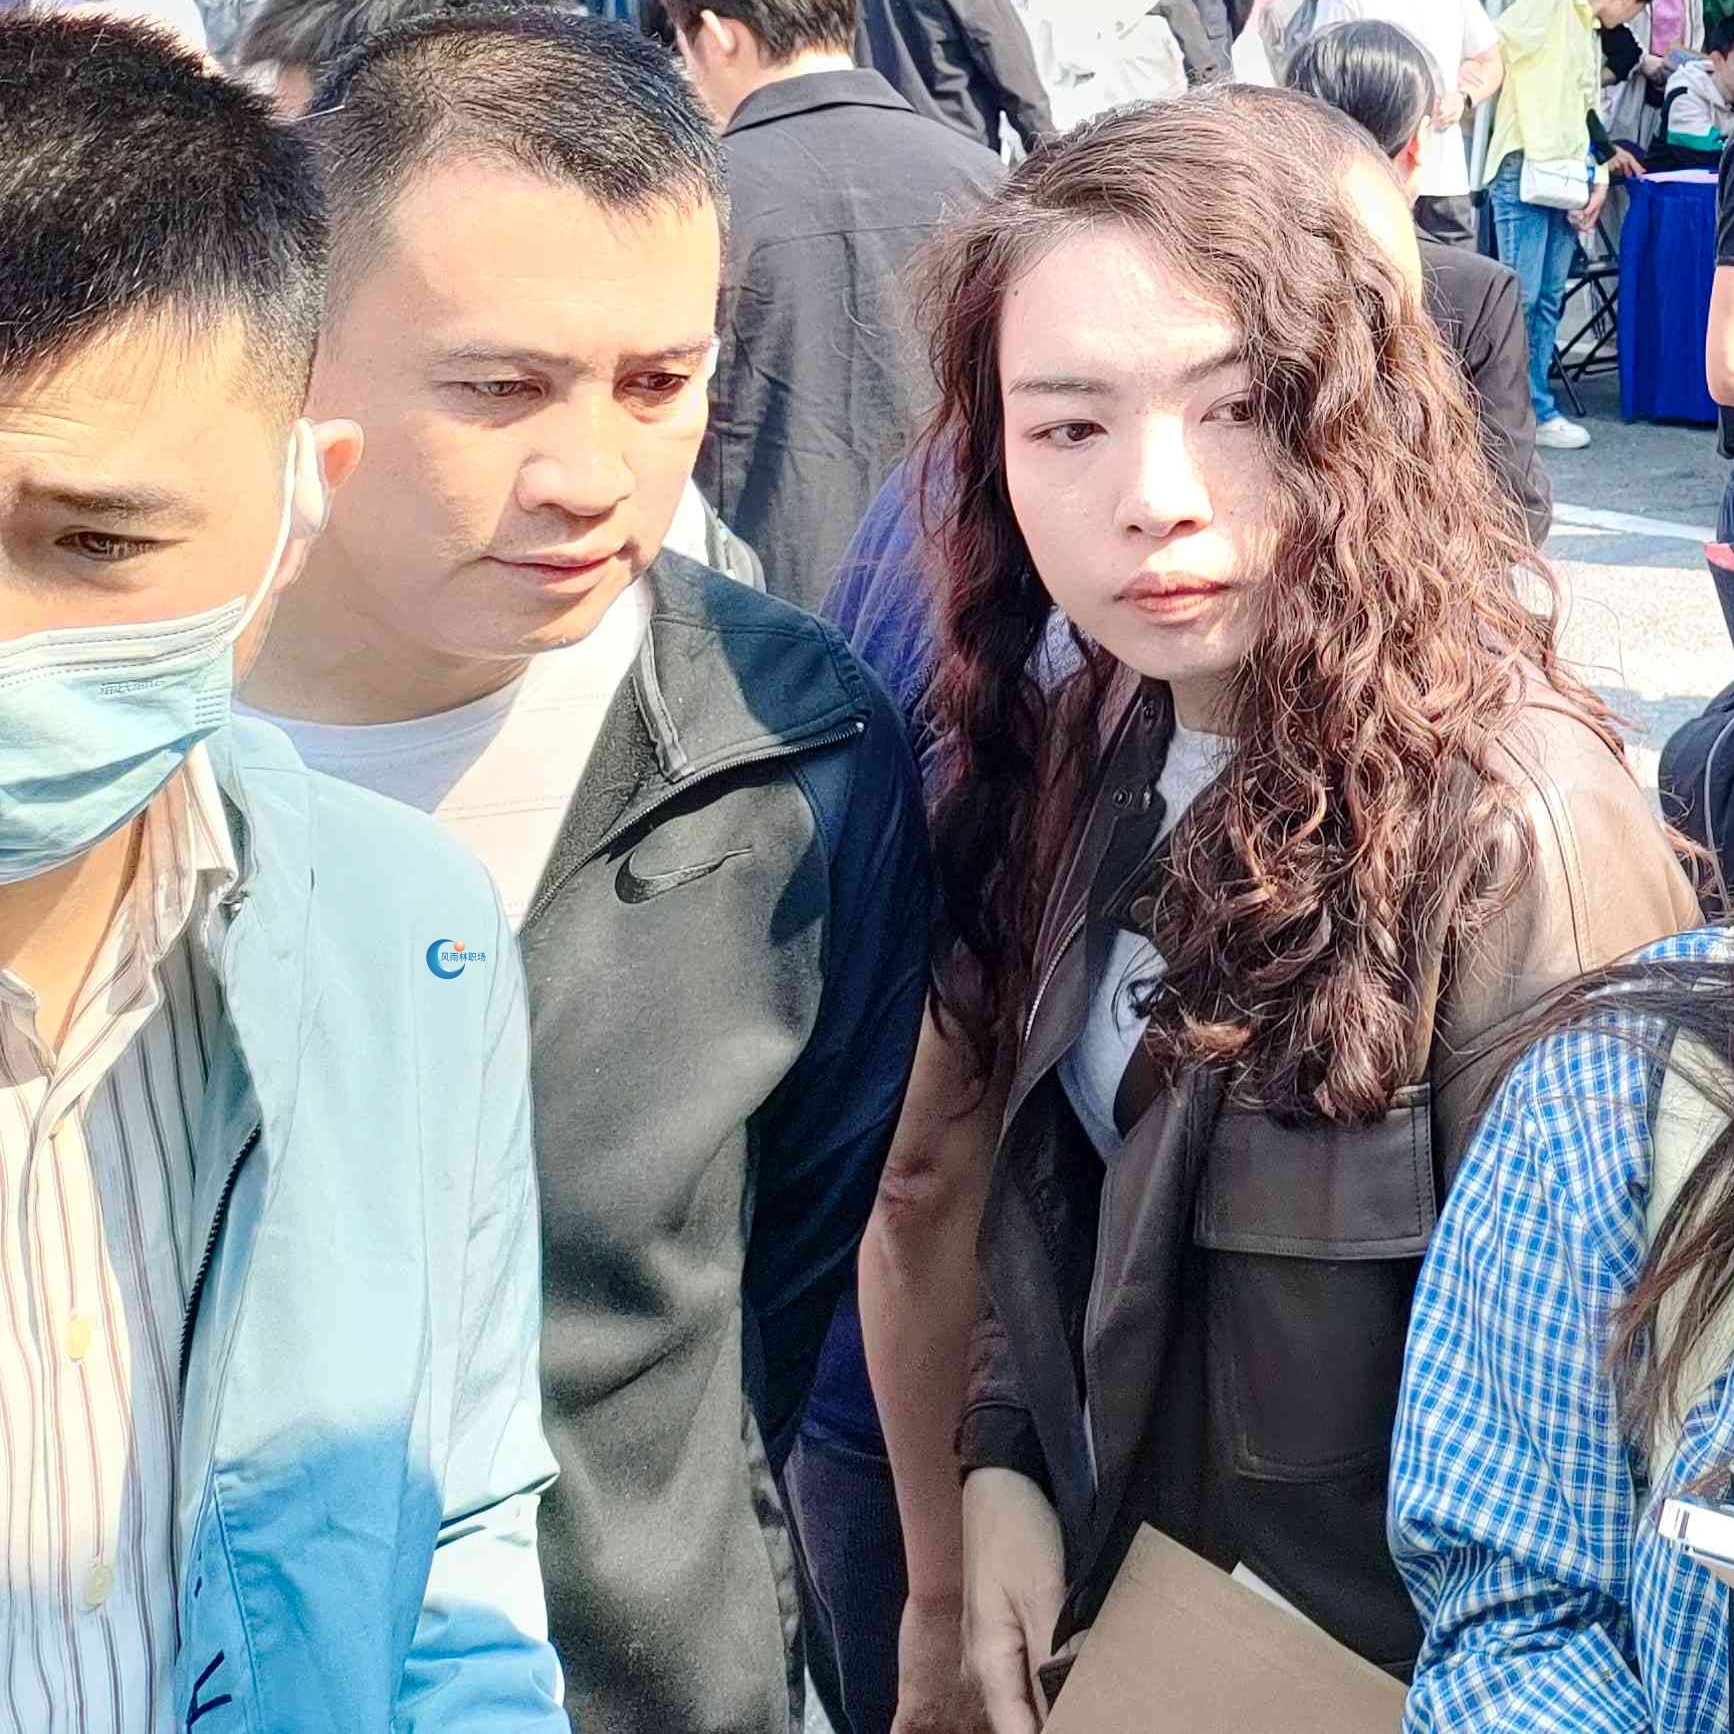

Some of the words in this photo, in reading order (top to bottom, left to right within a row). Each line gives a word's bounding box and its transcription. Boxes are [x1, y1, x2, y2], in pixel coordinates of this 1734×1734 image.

[440, 952, 487, 962] 风雨林职场
